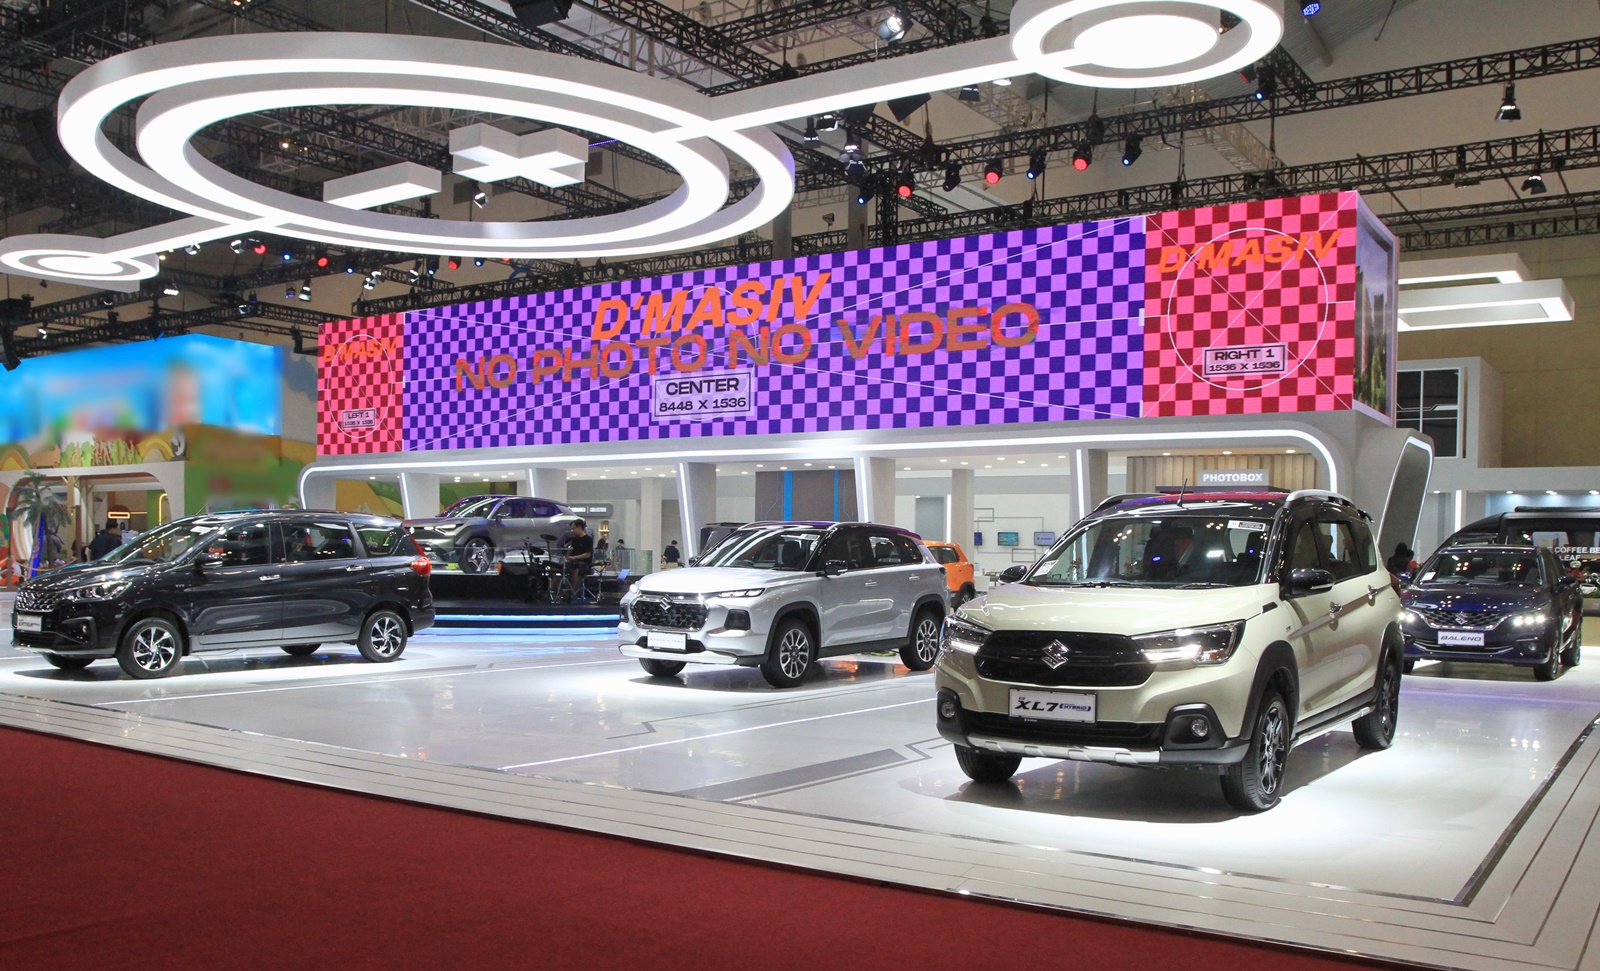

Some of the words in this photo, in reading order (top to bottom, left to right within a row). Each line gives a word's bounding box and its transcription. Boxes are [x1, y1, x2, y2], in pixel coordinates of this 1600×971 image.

[1157, 230, 1342, 274] D'MASIV
[590, 272, 832, 340] D'MASIV
[456, 353, 518, 392] NO
[532, 333, 707, 385] PHOTO
[728, 323, 813, 369] NO
[836, 302, 1040, 360] VIDEO
[1214, 349, 1261, 360] RIGHT
[1266, 349, 1275, 358] 1
[1209, 364, 1237, 372] 1536
[1252, 361, 1280, 369] 1536
[666, 377, 740, 396] CENTER
[659, 400, 694, 412] 8448
[698, 399, 708, 410] X
[713, 397, 747, 409] 1536
[1202, 473, 1263, 482] PHOTOBOX
[1554, 546, 1588, 554] COFFEE
[1014, 700, 1059, 712] XL7
